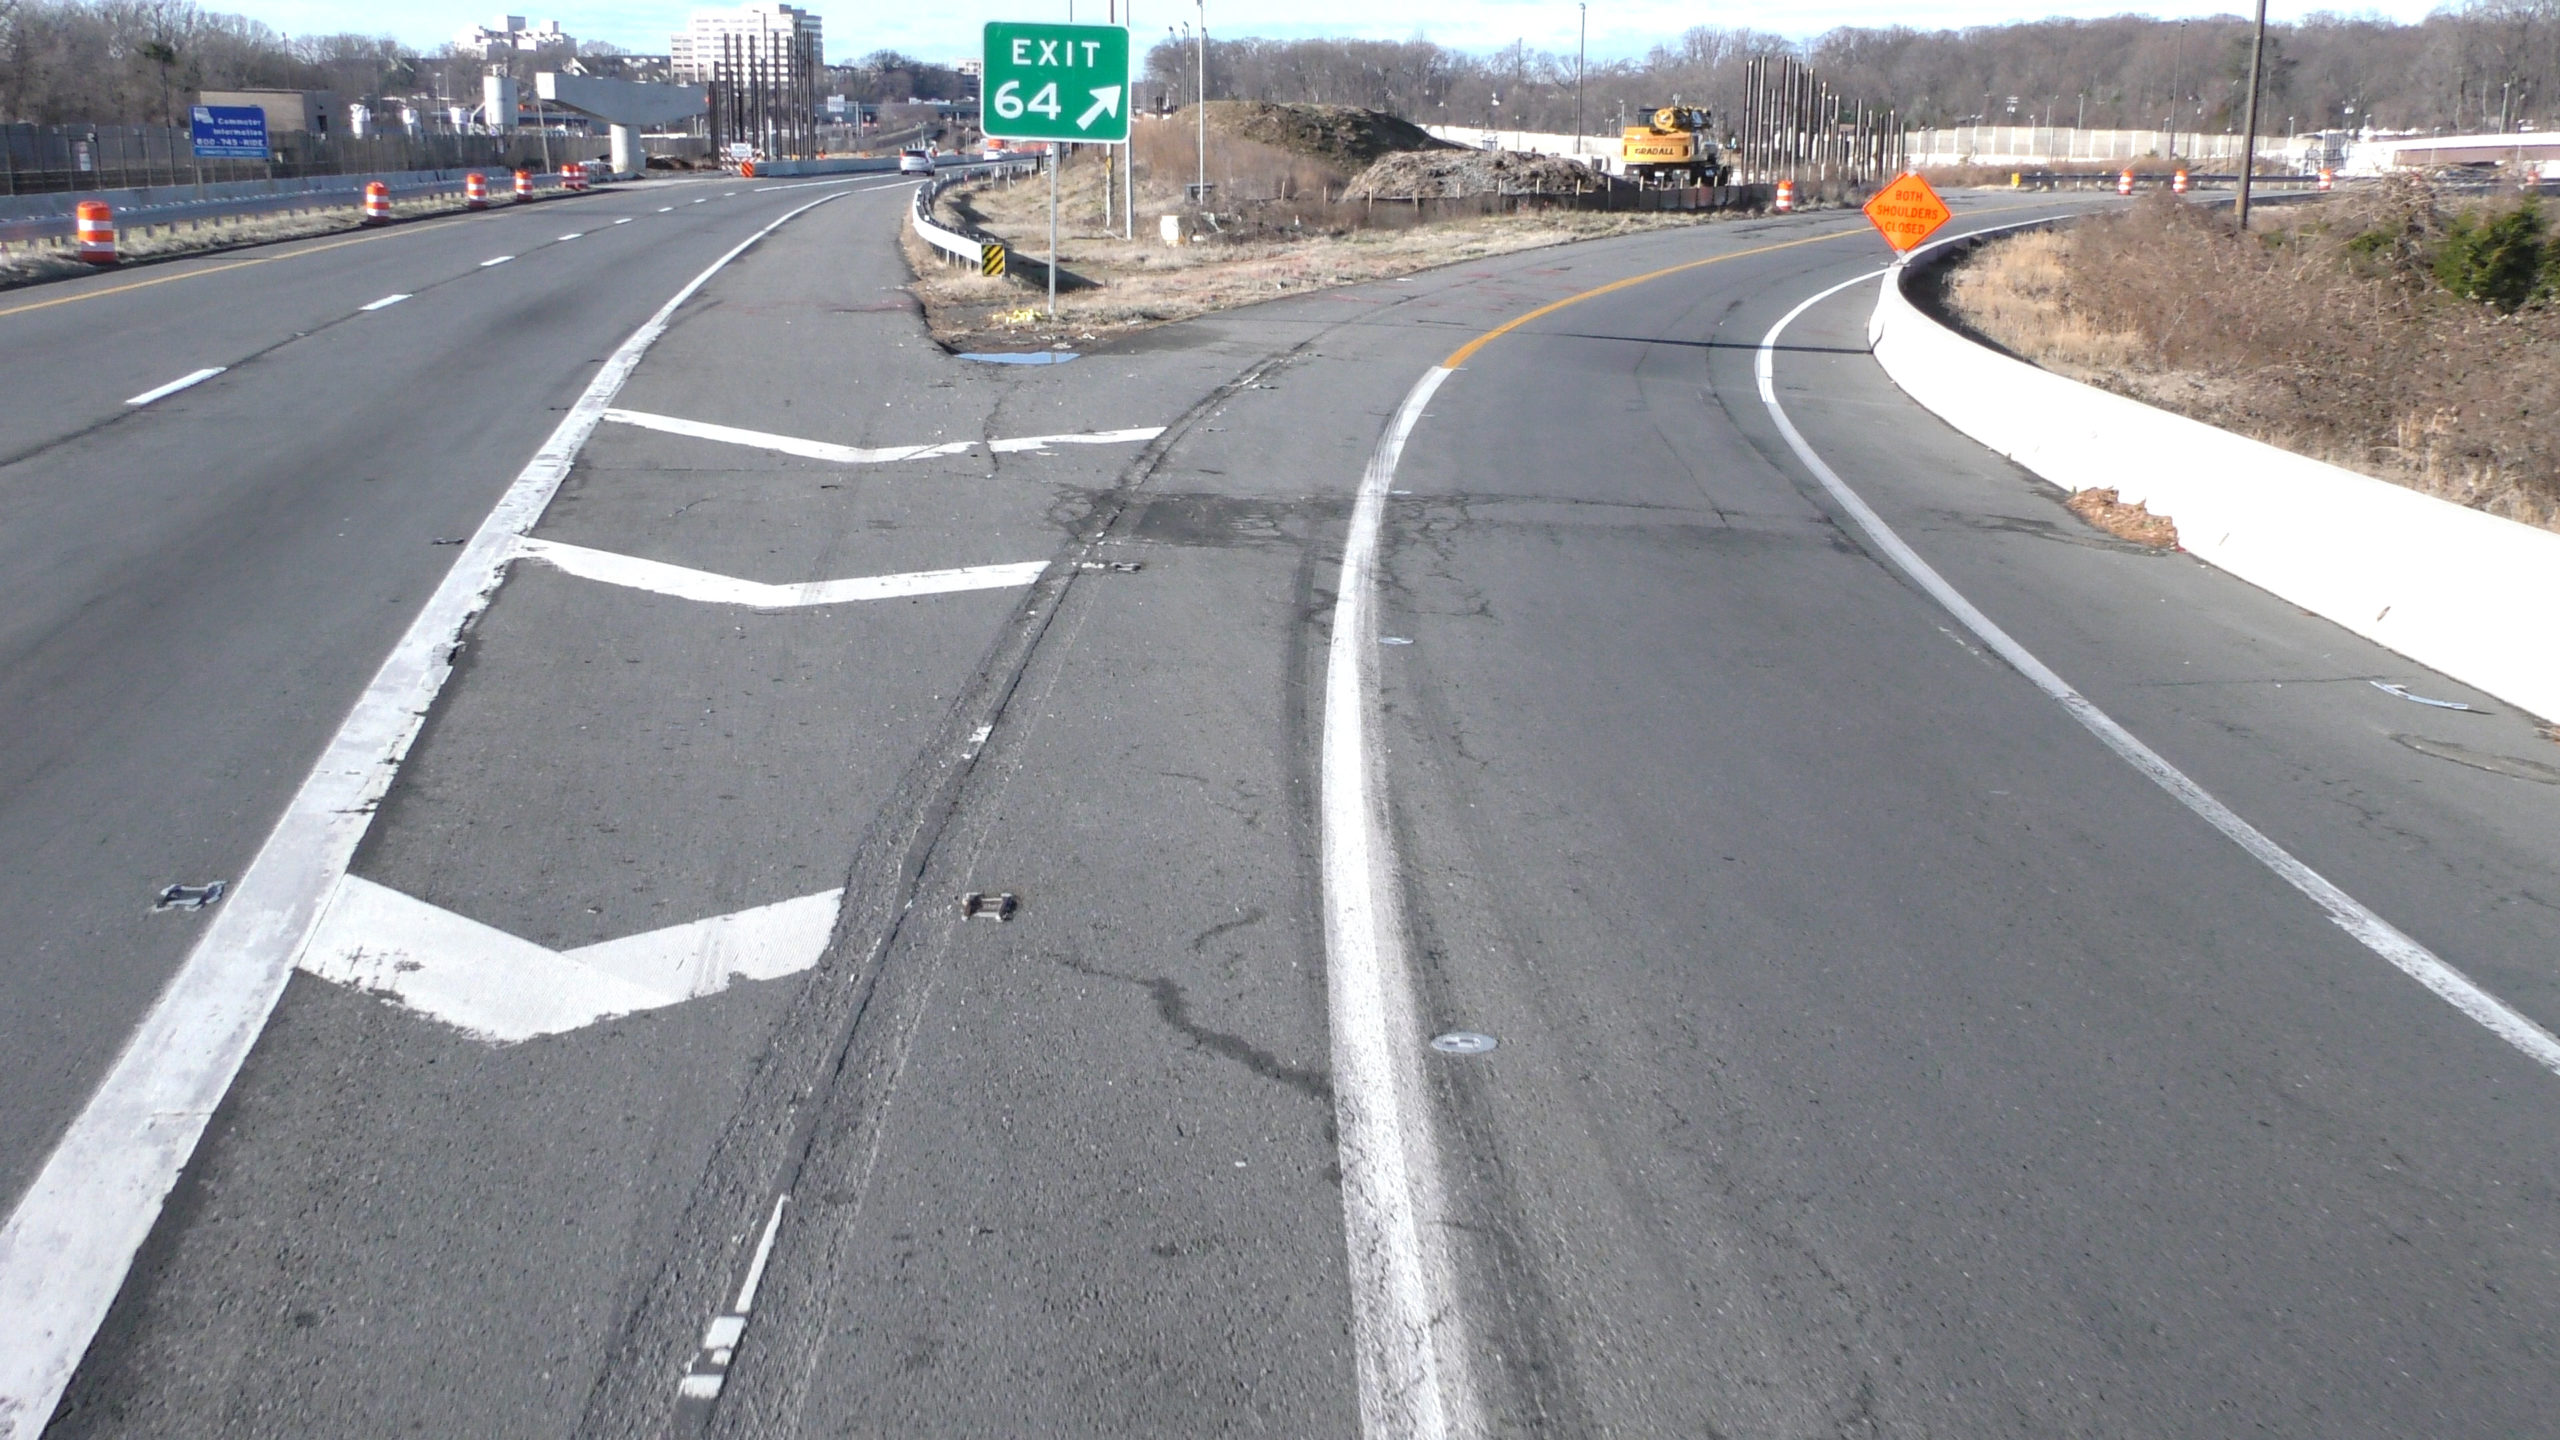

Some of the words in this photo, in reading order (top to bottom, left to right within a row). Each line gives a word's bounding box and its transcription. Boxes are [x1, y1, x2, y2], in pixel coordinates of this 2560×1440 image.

[1012, 38, 1100, 68] EXIT
[994, 80, 1062, 120] 64
[217, 118, 261, 126] Commuter
[213, 128, 263, 136] Information
[1635, 147, 1675, 155] GRADALL
[1895, 190, 1924, 202] BOTH
[1876, 204, 1938, 220] SHOULDERS
[1885, 221, 1926, 235] CLOSED
